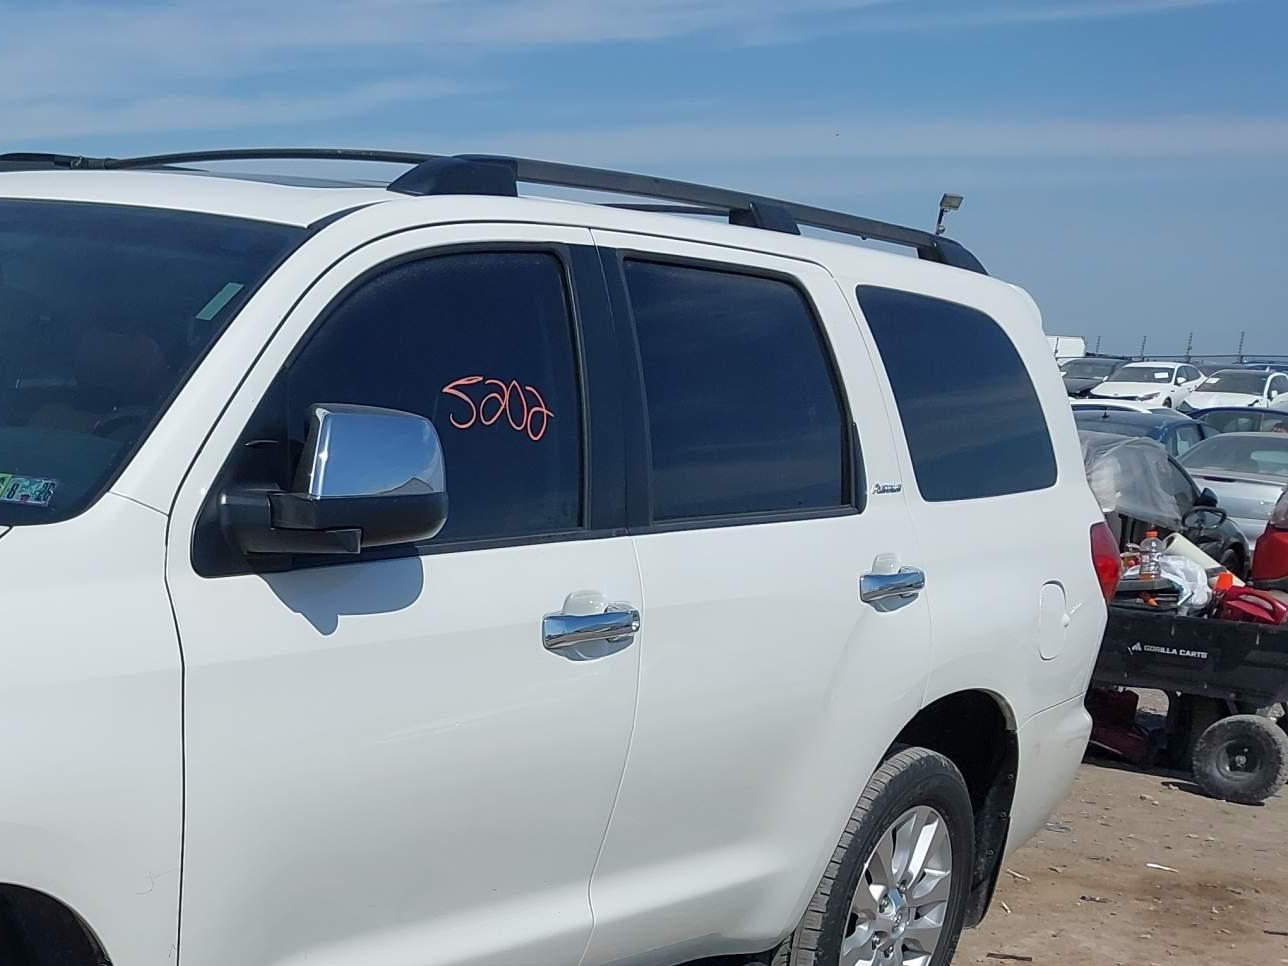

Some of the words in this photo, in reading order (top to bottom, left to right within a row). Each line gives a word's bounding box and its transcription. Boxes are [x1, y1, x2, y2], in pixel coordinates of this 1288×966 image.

[442, 375, 555, 441] 5202
[1144, 646, 1177, 655] GORILLA
[1179, 650, 1208, 659] CARTS
